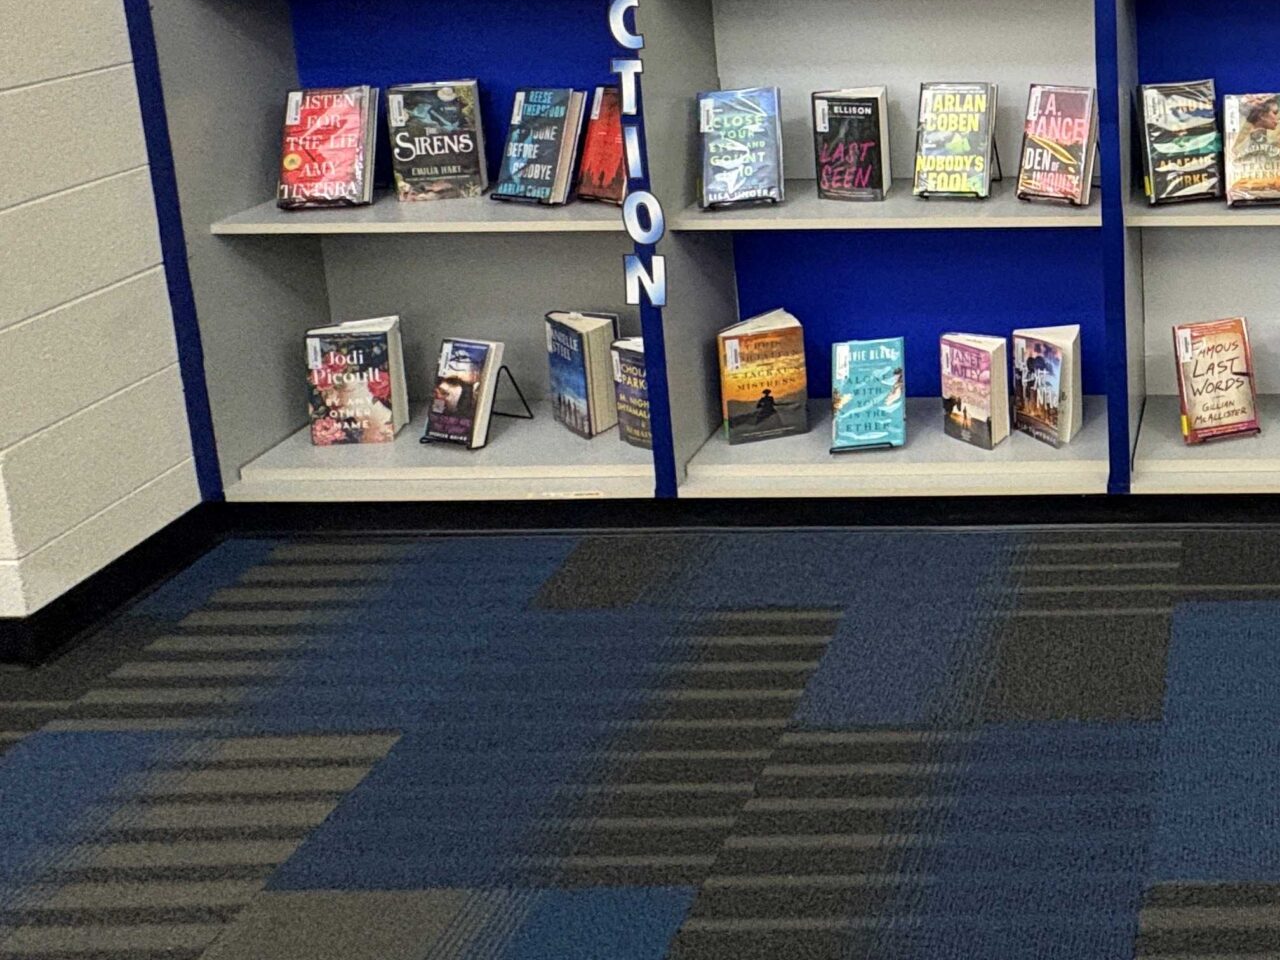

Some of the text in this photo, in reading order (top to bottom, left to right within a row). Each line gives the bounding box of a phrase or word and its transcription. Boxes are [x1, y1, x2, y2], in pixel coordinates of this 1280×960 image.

[529, 90, 554, 104] REESE
[833, 106, 873, 116] ELLISON
[307, 115, 341, 129] FOR
[713, 115, 763, 129] CLOSE
[925, 113, 981, 132] COBEN
[286, 133, 358, 152] THE LIE
[719, 128, 755, 140] YOUR
[394, 131, 474, 162] SIRENS
[507, 142, 540, 158] BEFORE
[819, 140, 876, 163] LAST
[916, 154, 984, 172] NOBODY'S
[1025, 147, 1052, 170] DEN
[298, 162, 337, 178] AMY
[441, 166, 462, 175] HART
[820, 164, 873, 190] SEEN
[927, 171, 969, 193] FOOL
[328, 349, 365, 366] Jodi
[951, 347, 982, 369] JANET
[1190, 340, 1239, 359] FAMOUS
[1192, 356, 1240, 378] LAST
[313, 367, 382, 385] Picoult
[736, 376, 796, 392] MISTRESS
[852, 386, 883, 397] WITH
[1190, 377, 1245, 398] WORDS
[1201, 400, 1236, 412] GILLIAN
[332, 420, 369, 430] NAME
[845, 422, 890, 433] ETHER
